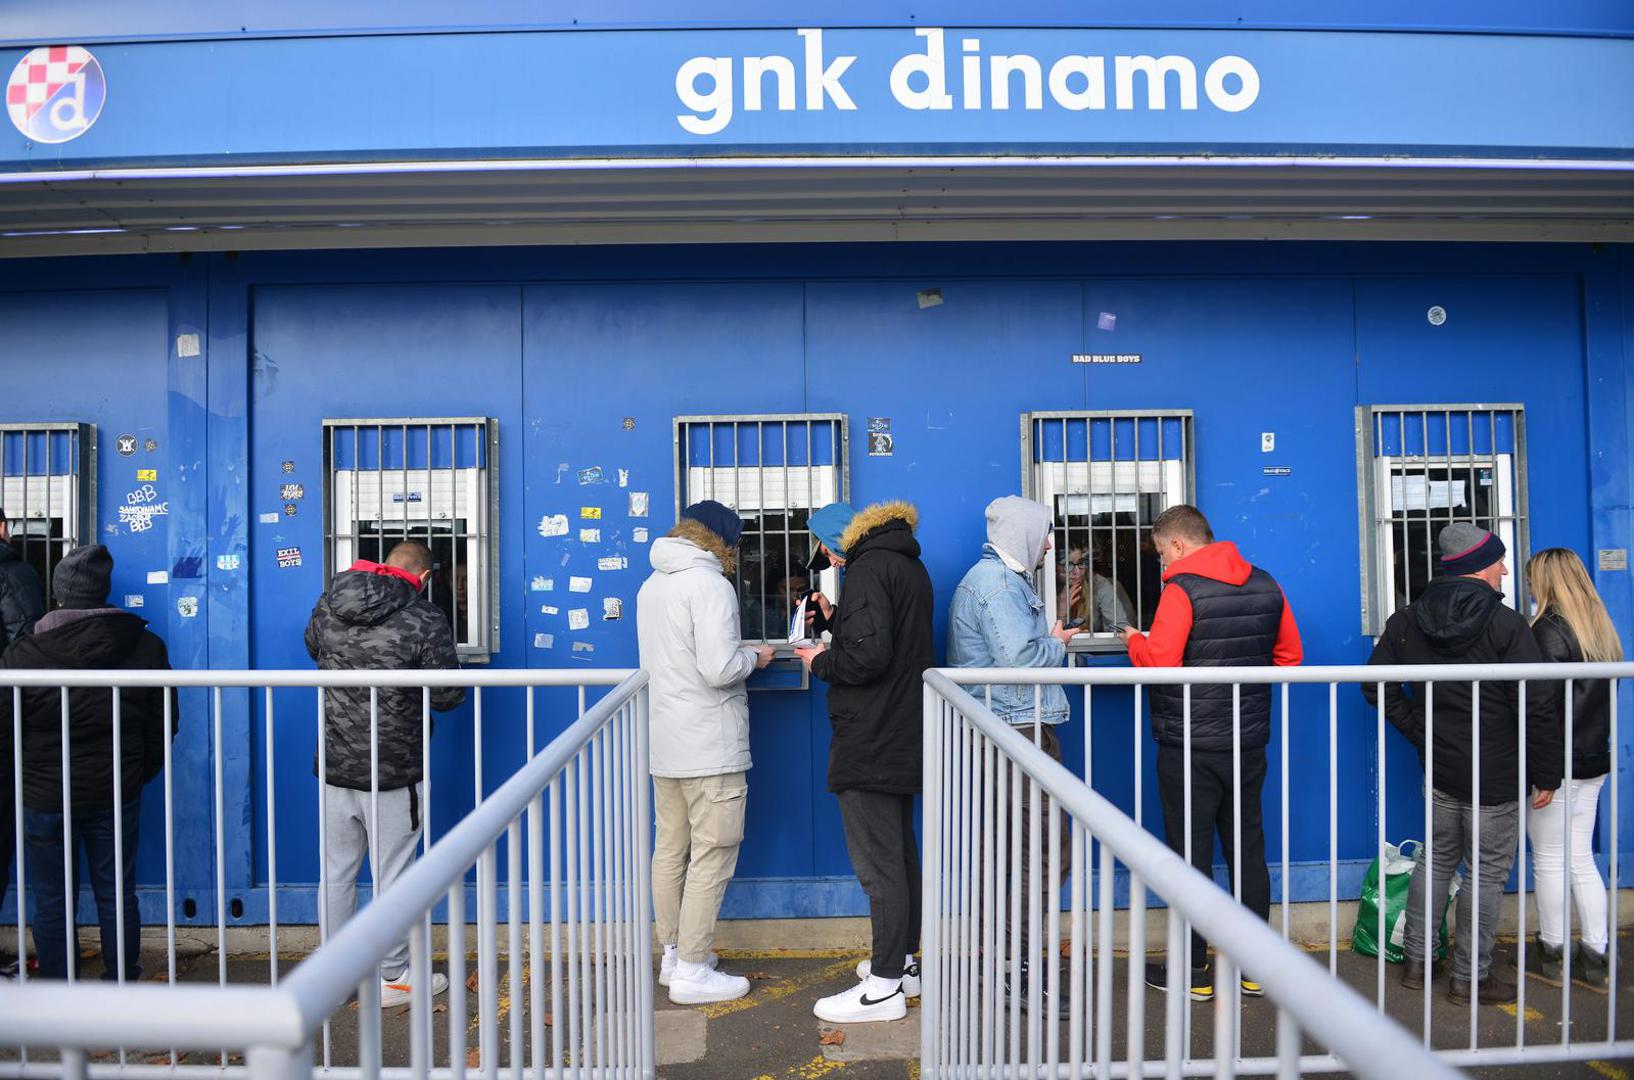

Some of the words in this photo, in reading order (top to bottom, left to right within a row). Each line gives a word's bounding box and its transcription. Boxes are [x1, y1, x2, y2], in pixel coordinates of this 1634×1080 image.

[675, 28, 858, 135] gnk
[889, 28, 1260, 112] dinamo
[1073, 355, 1091, 363] BAD
[1092, 355, 1115, 363] BLUE
[1117, 355, 1140, 363] BOYS
[279, 559, 302, 568] BOYS
